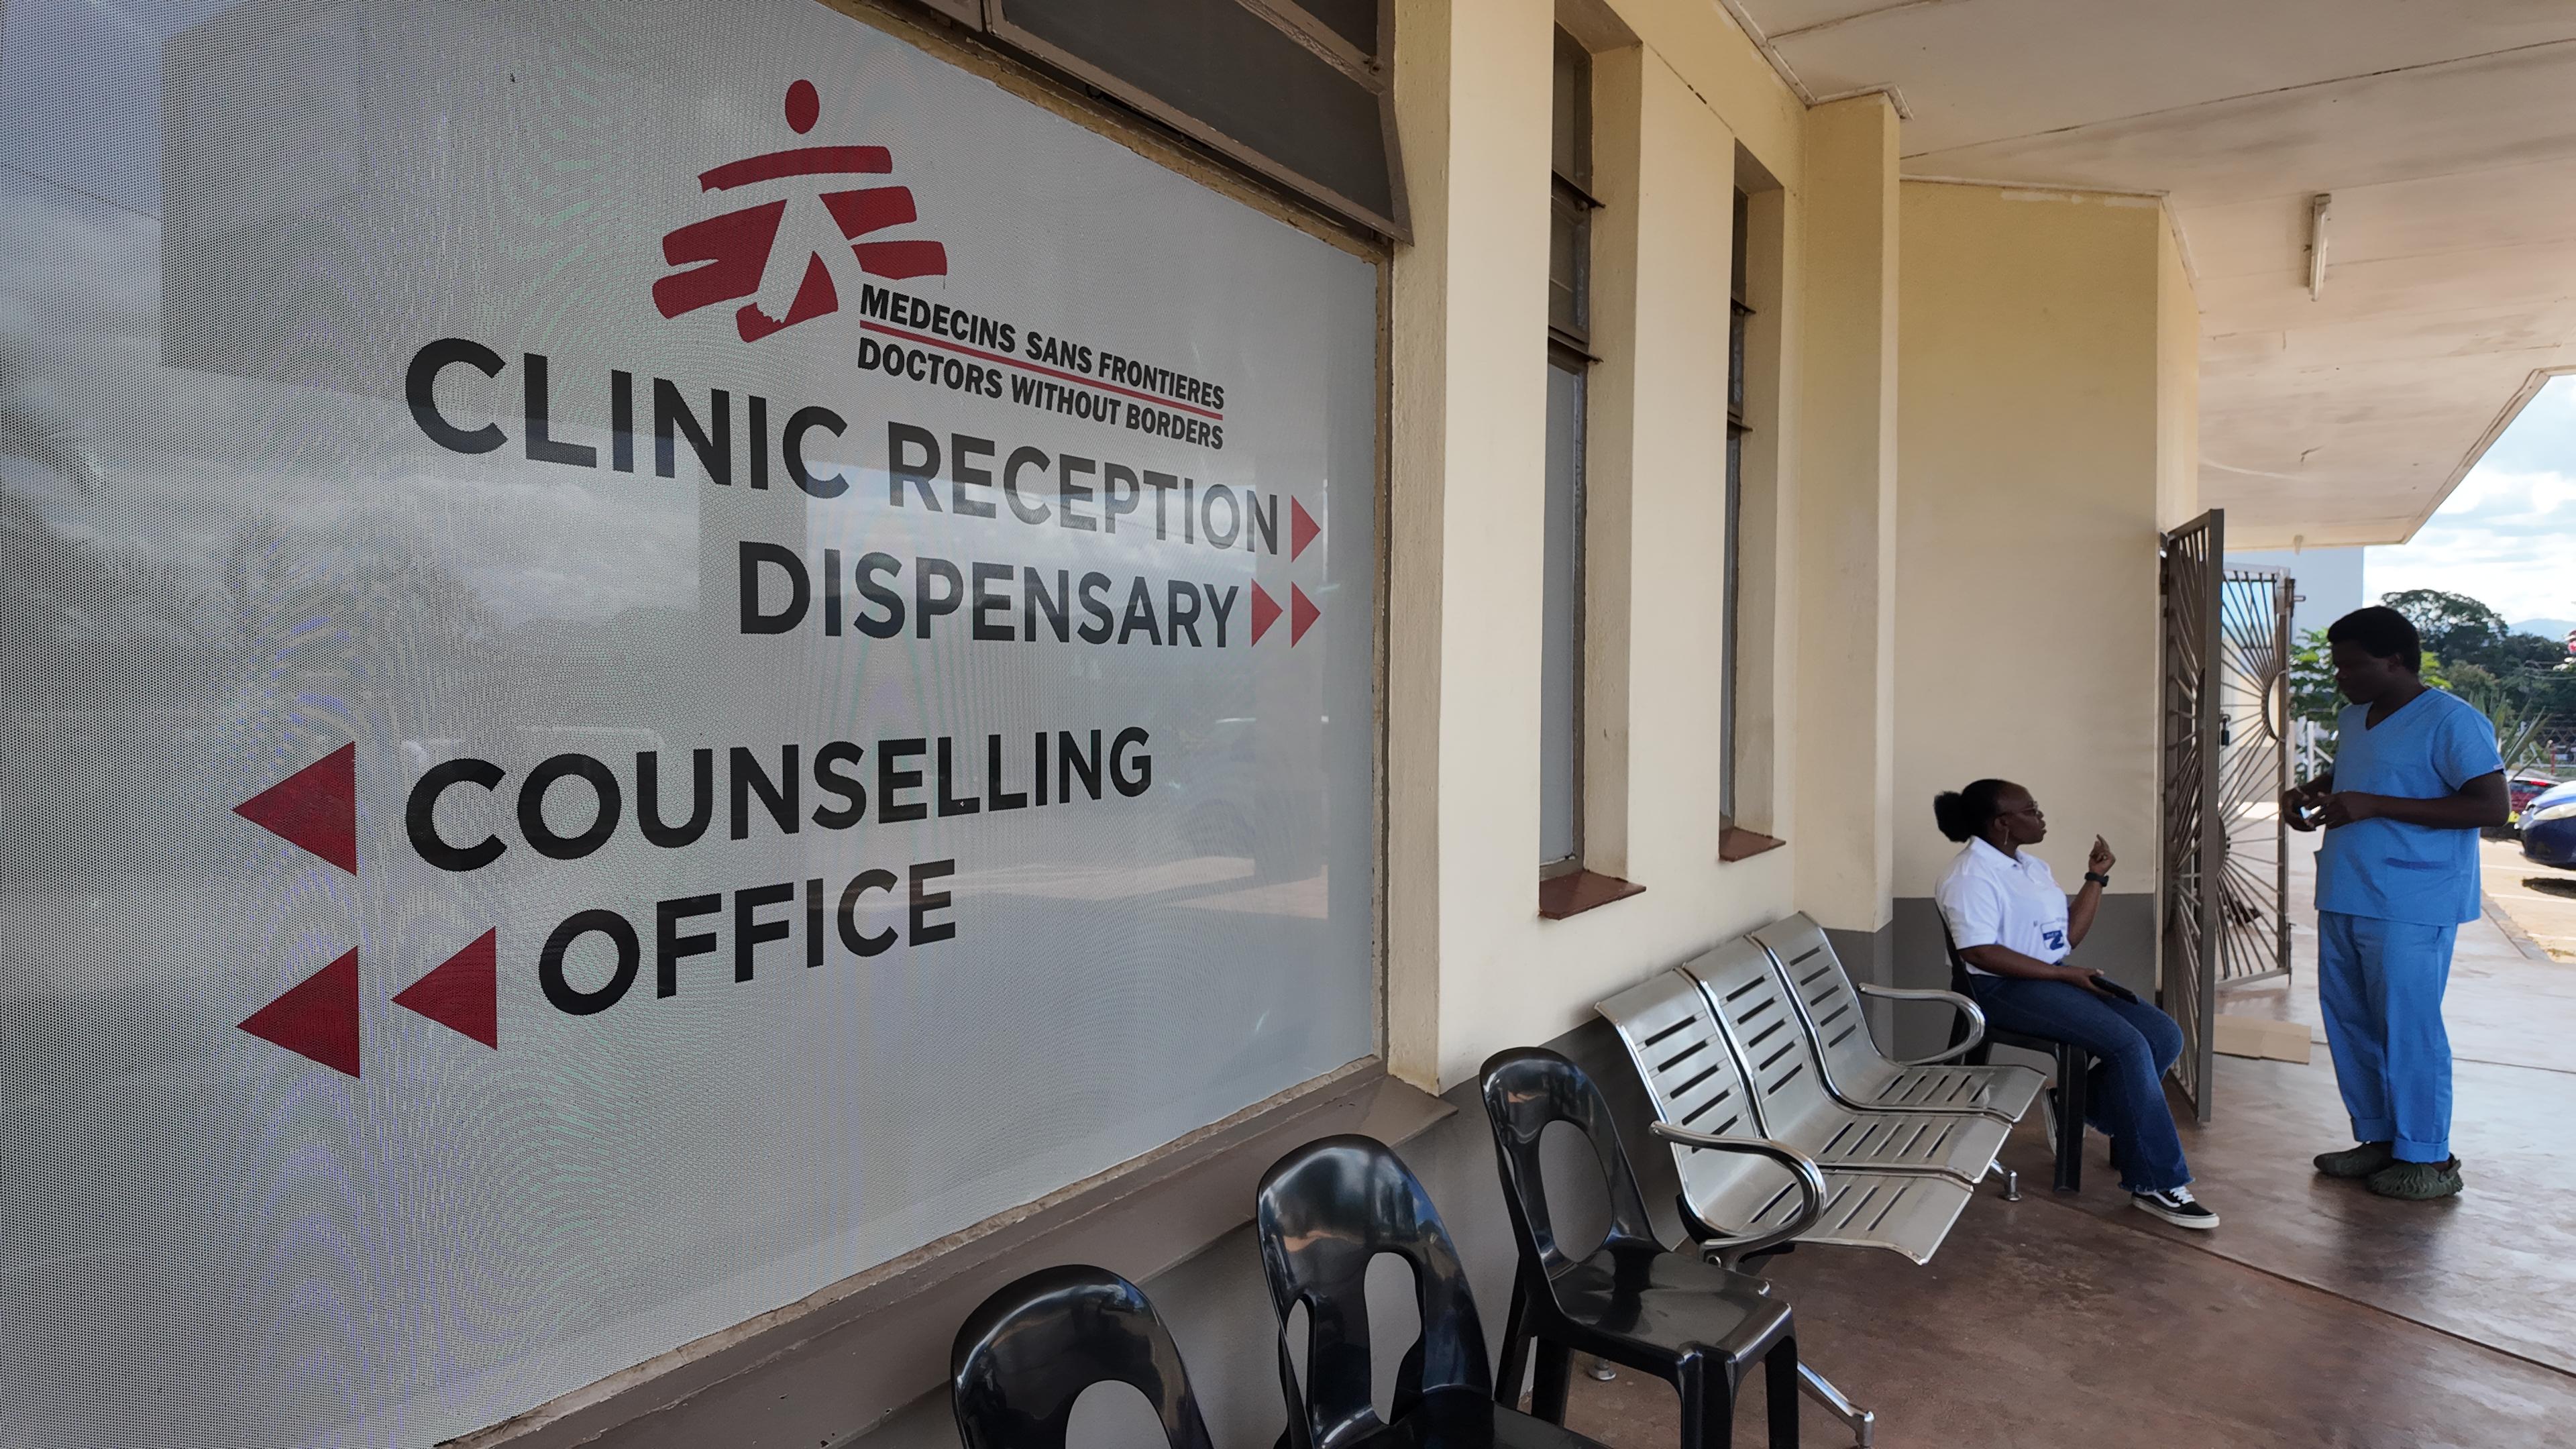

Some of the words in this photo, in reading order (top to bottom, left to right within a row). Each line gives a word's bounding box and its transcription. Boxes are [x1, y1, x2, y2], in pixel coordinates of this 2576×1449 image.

[857, 337, 1002, 400] DOCTORS
[1011, 374, 1122, 426] WITHOUT
[1126, 403, 1224, 450] BORDERS
[860, 283, 1016, 353] MEDECINS
[1026, 331, 1092, 374] SANS
[1098, 352, 1225, 409] FRONTIERES
[405, 337, 850, 499] CLINIC
[888, 420, 1278, 555] RECEPTION
[739, 540, 1239, 648] DISPENSARY
[405, 726, 1152, 872] COUNSELLING
[539, 858, 956, 1016] OFFICE
